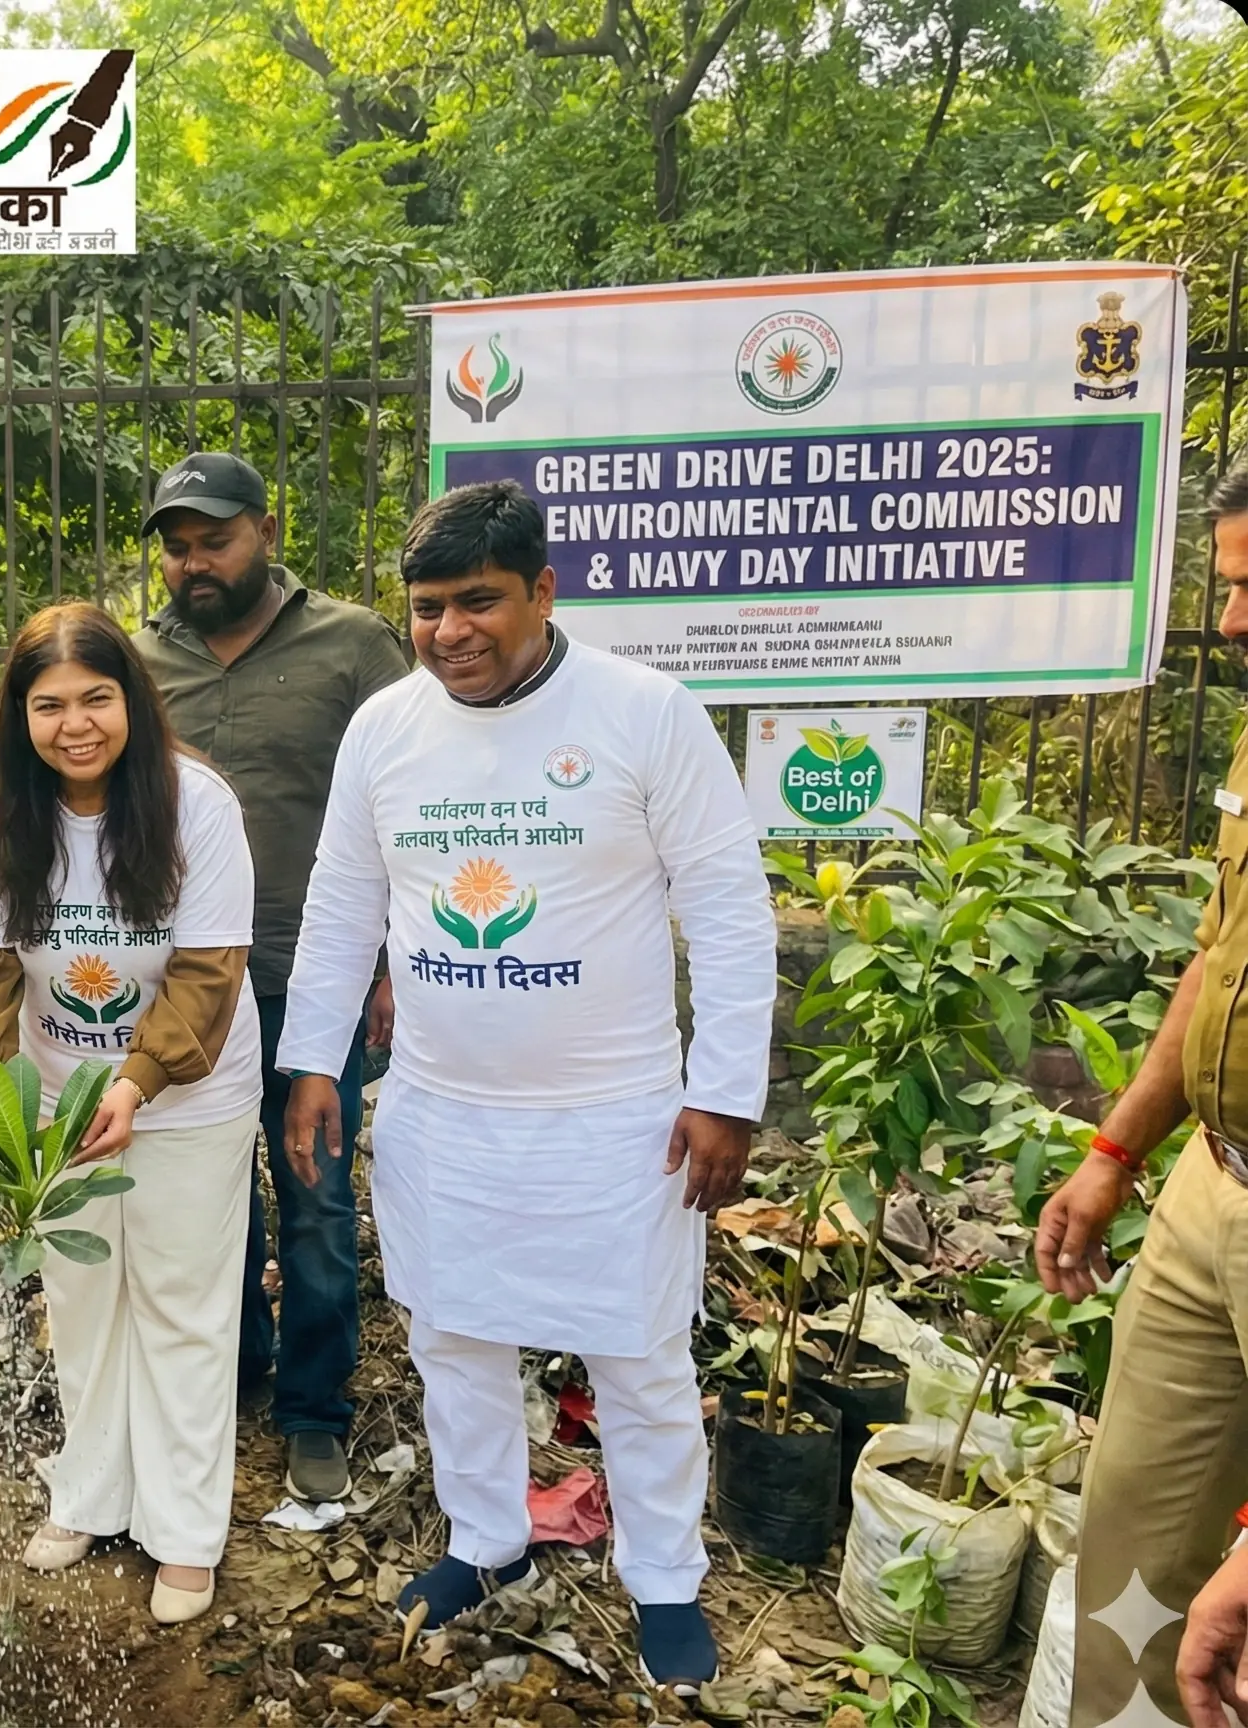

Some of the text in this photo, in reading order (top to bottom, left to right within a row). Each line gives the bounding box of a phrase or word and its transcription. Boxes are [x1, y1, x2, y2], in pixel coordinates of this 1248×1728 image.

[535, 436, 1052, 494] GREEN DRIVE DELHI 2025:
[546, 485, 1123, 542] ENVIRONMENTAL COMMISSION
[586, 539, 1026, 590] & NAVY DAY INITIATIVE
[788, 765, 878, 787] Best of
[419, 796, 548, 821] पर्यावरण वन एवं
[802, 790, 870, 813] Delhi
[393, 822, 584, 854] जलवायु परिवर्तन आयोग
[64, 924, 120, 947] परिवर्तन
[408, 948, 582, 991] नौसेना दिवस
[38, 1015, 106, 1048] नौसेना
